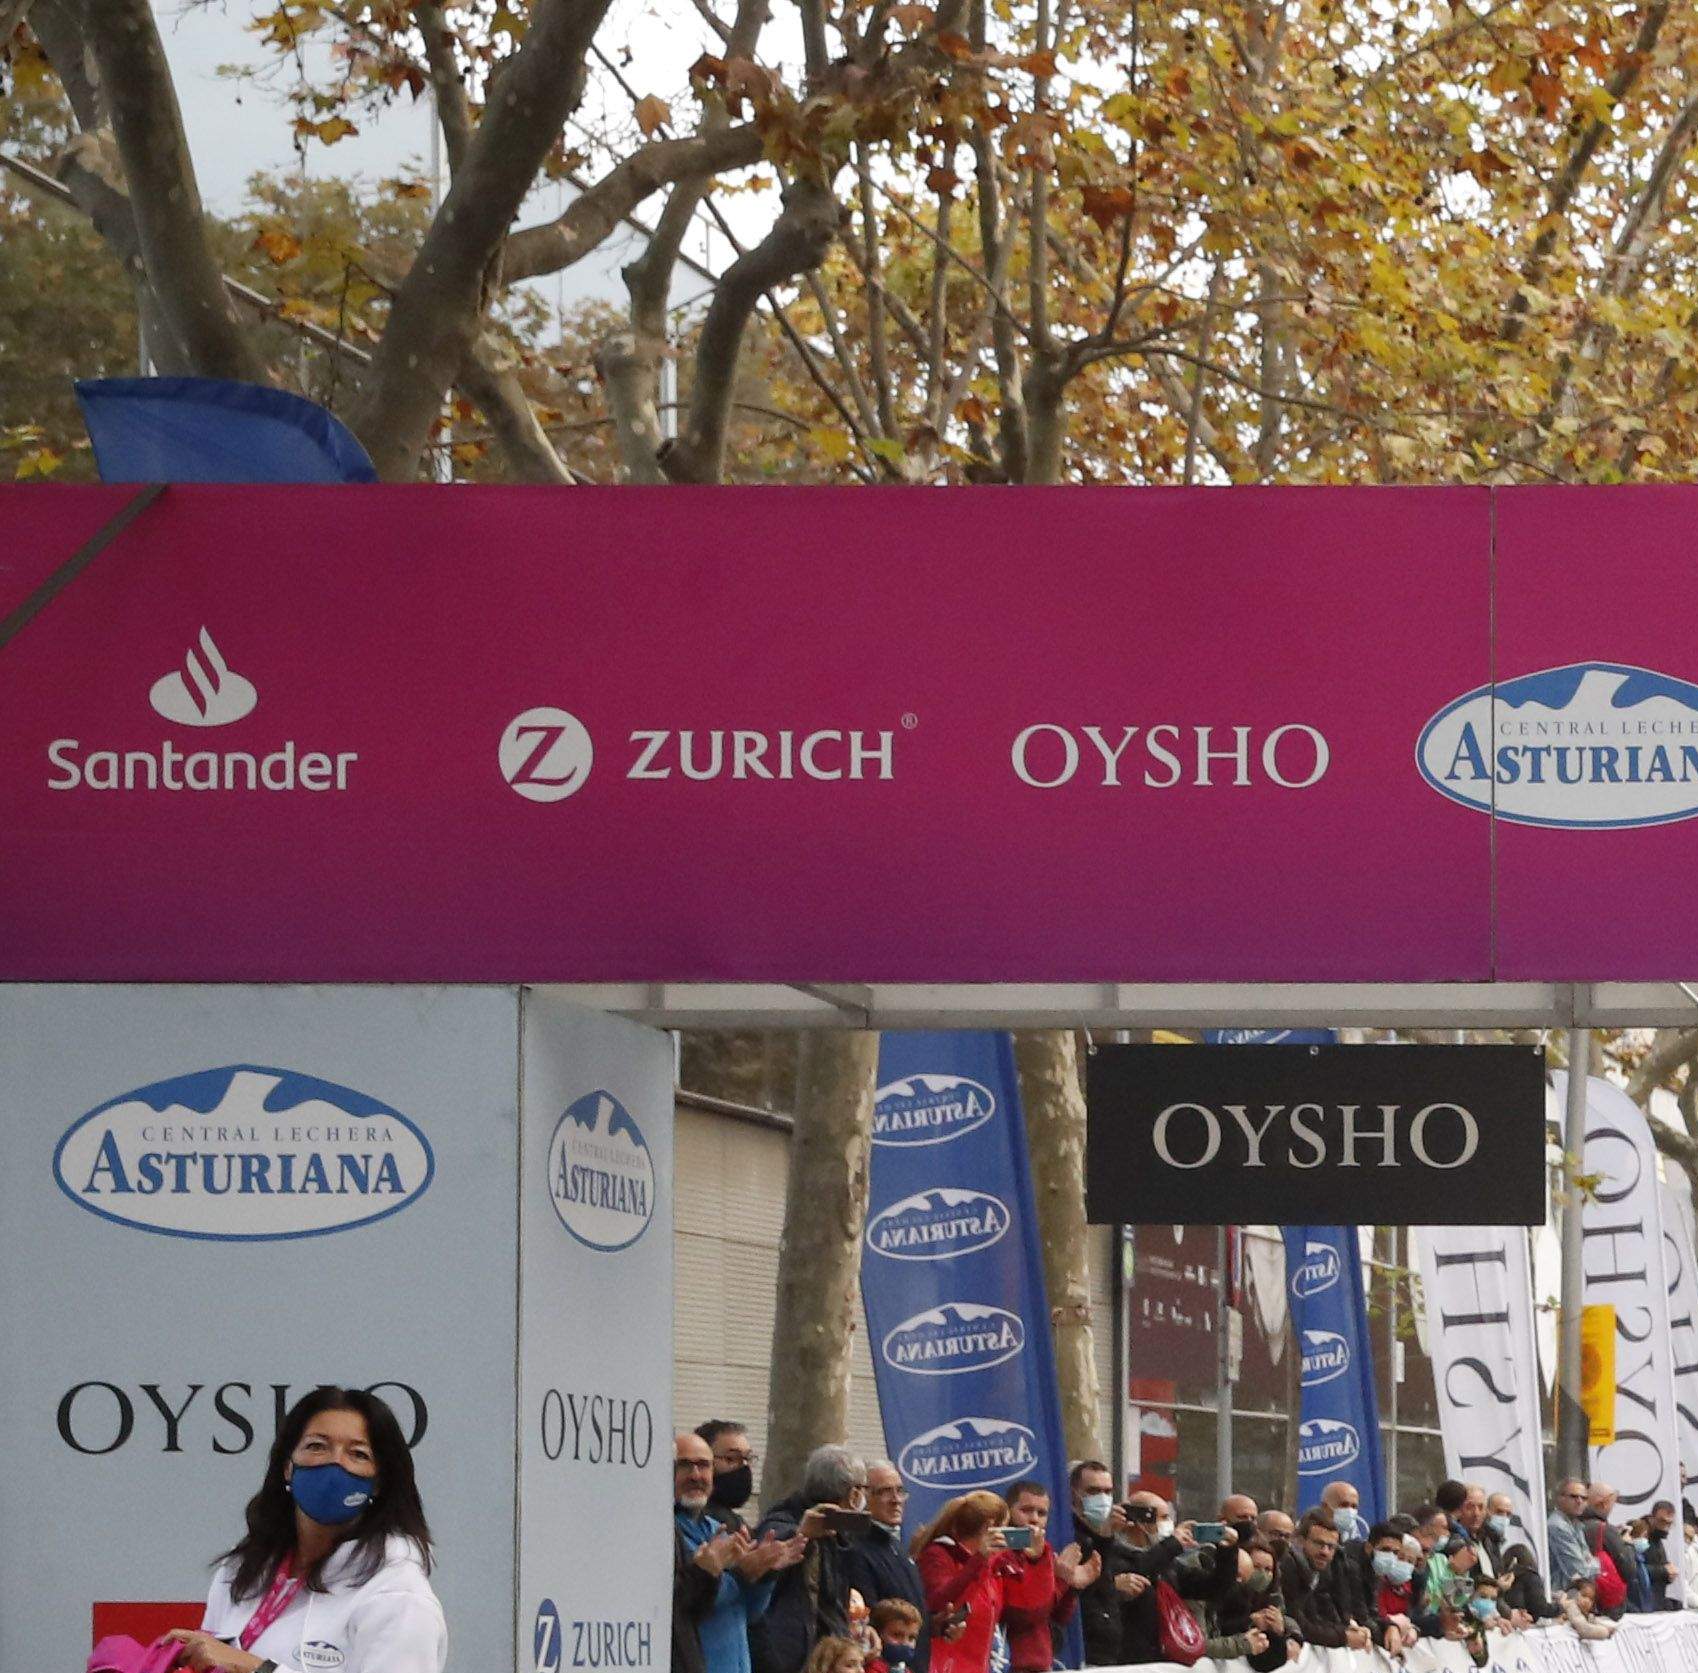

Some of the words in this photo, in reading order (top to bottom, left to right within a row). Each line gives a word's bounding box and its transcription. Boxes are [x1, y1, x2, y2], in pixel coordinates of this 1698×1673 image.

[627, 728, 894, 781] ZURICH
[1011, 723, 1331, 790] OYSHO
[1500, 720, 1608, 735] CENTRAL
[48, 739, 358, 792] Santander
[83, 1128, 406, 1196] ASTURIANA
[142, 1125, 258, 1143] CENTRAL
[273, 1126, 395, 1142] LECHERA
[1152, 1101, 1480, 1170] OYSHO
[555, 1138, 648, 1220] ASTURIANA
[540, 1387, 654, 1469] OYSHO
[571, 1620, 653, 1668] ZURICH
